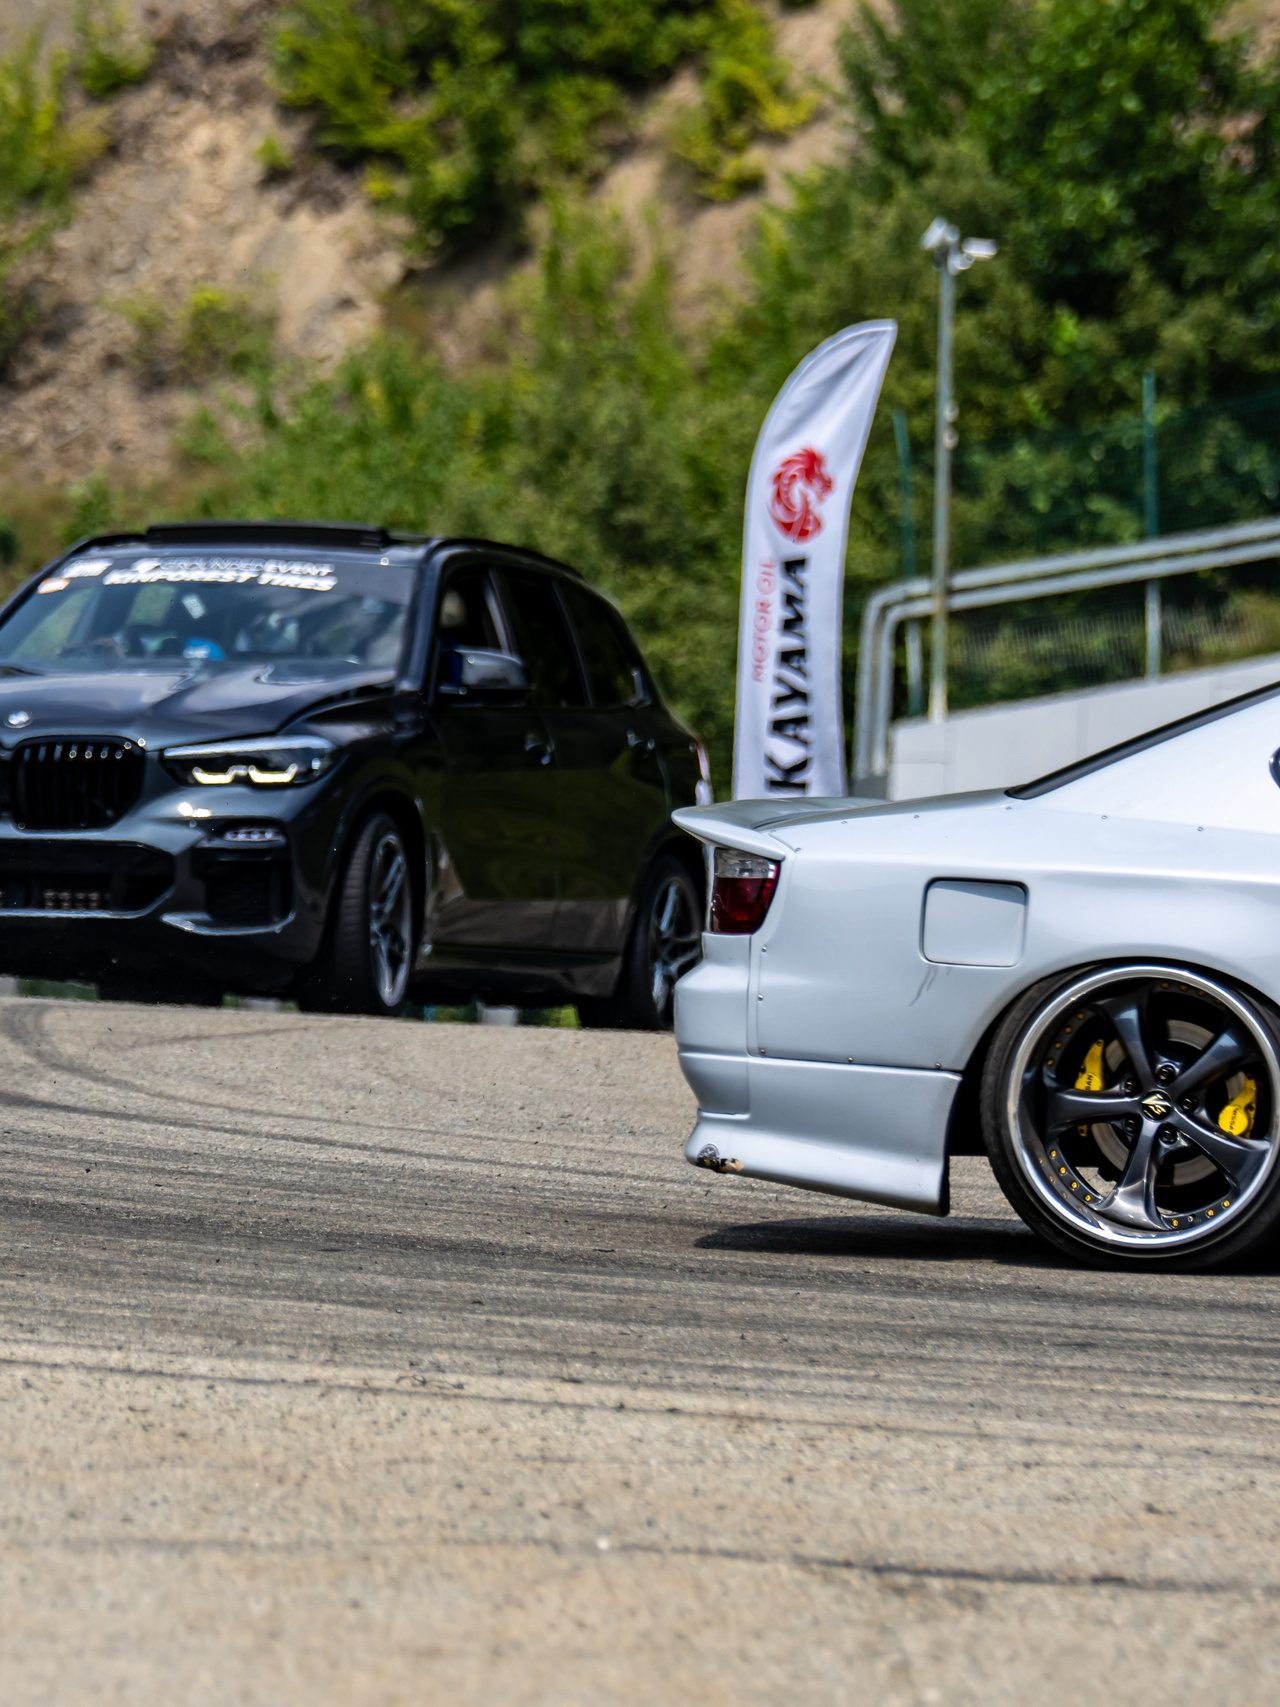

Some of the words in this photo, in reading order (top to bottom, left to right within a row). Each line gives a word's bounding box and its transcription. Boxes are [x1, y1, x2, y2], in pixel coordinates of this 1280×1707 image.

[257, 571, 338, 591] TIRES
[756, 557, 777, 596] OIL
[751, 597, 772, 682] MOTOR
